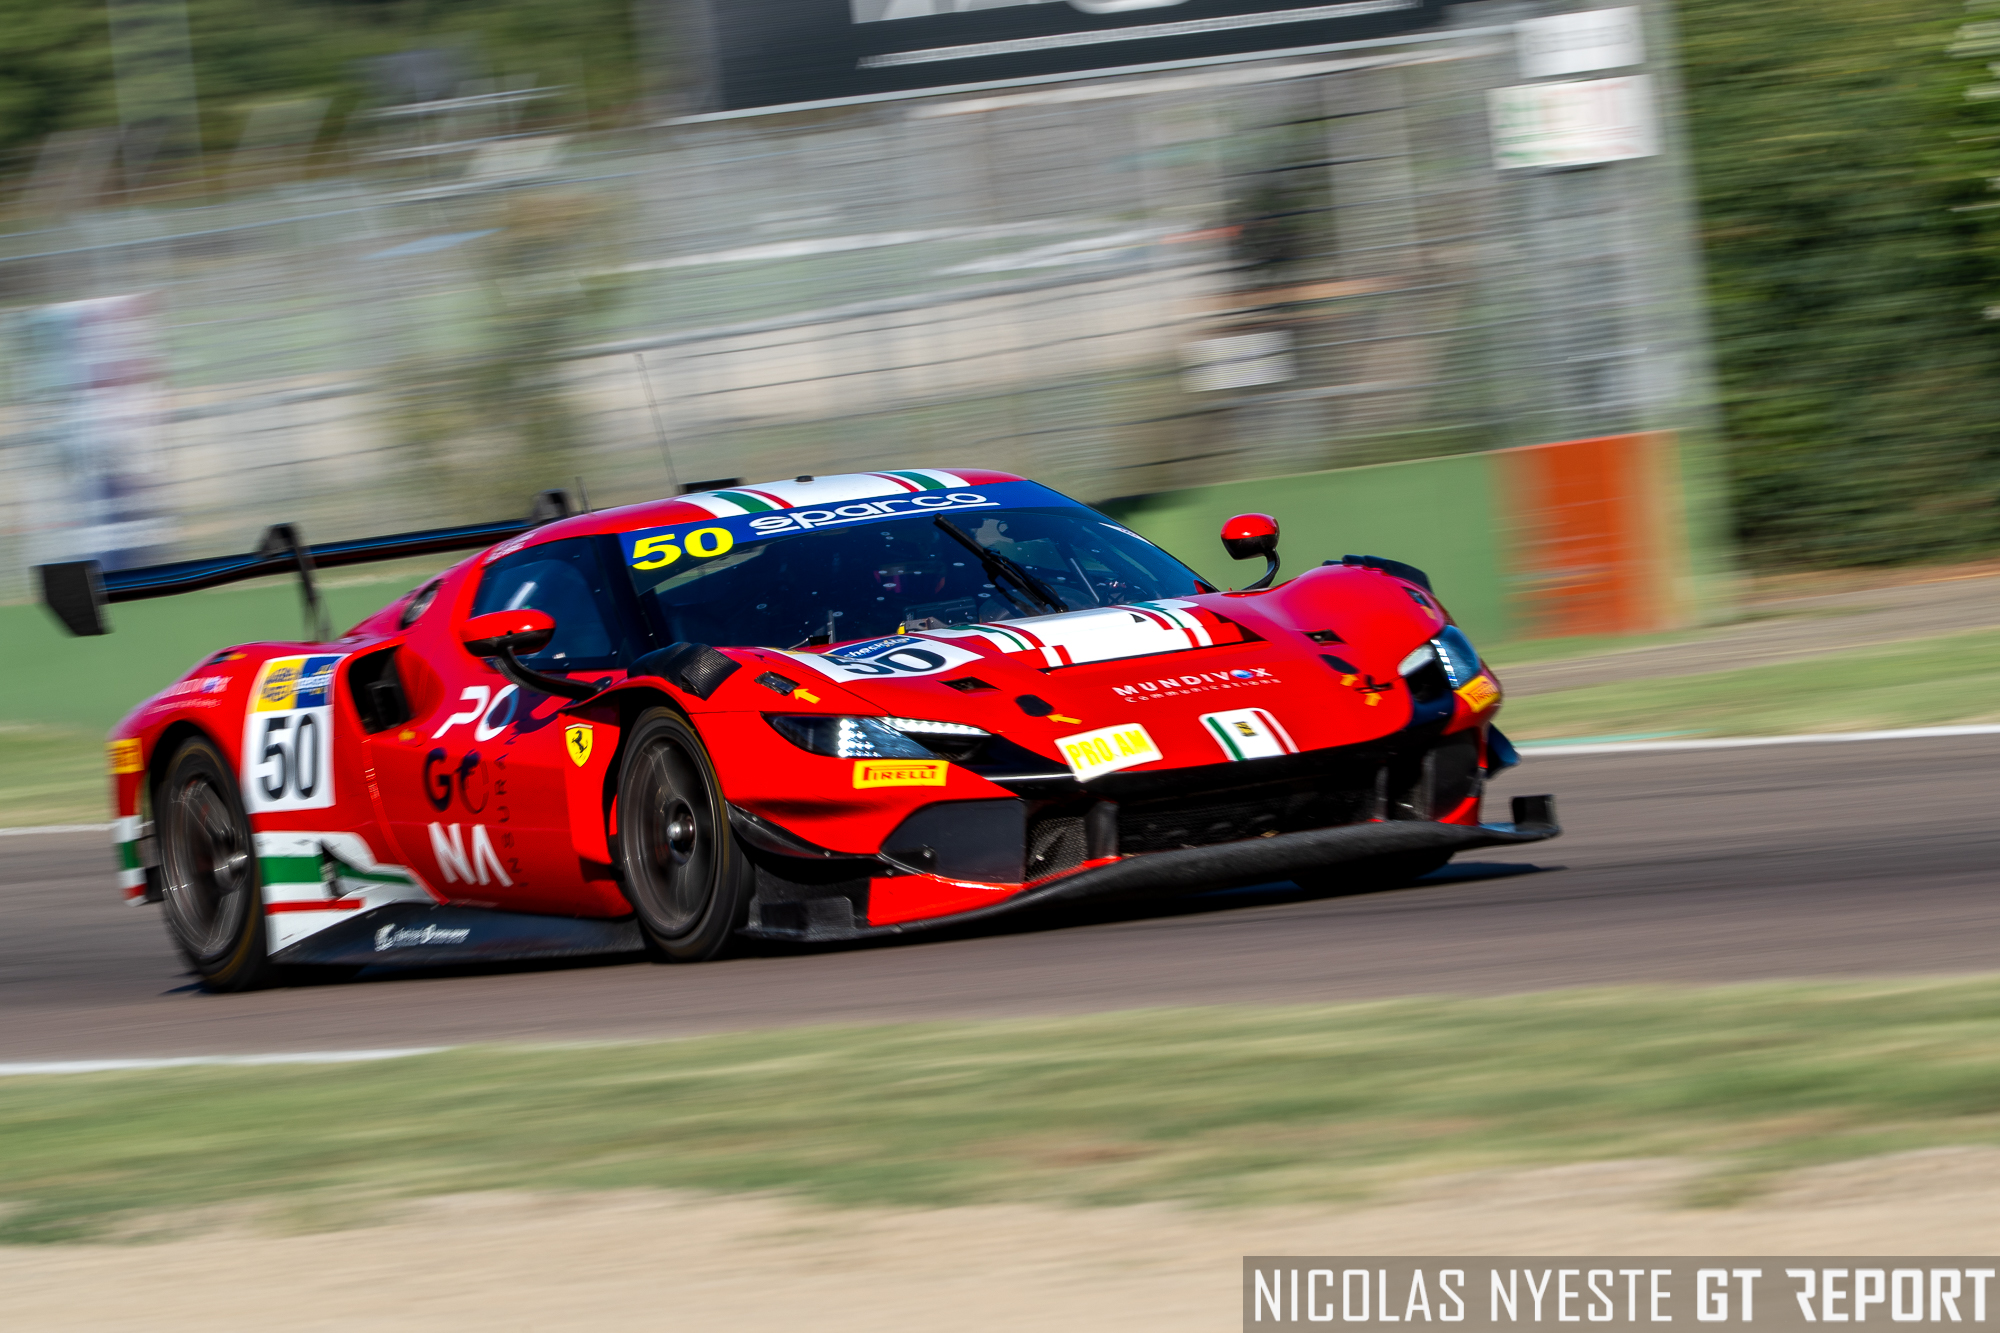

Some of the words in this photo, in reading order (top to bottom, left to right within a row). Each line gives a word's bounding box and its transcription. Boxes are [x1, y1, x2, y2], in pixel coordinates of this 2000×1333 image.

[749, 492, 988, 530] sparco
[632, 527, 734, 570] 50
[817, 648, 946, 675] 50
[260, 713, 318, 800] 50
[862, 764, 939, 781] PIRELLI
